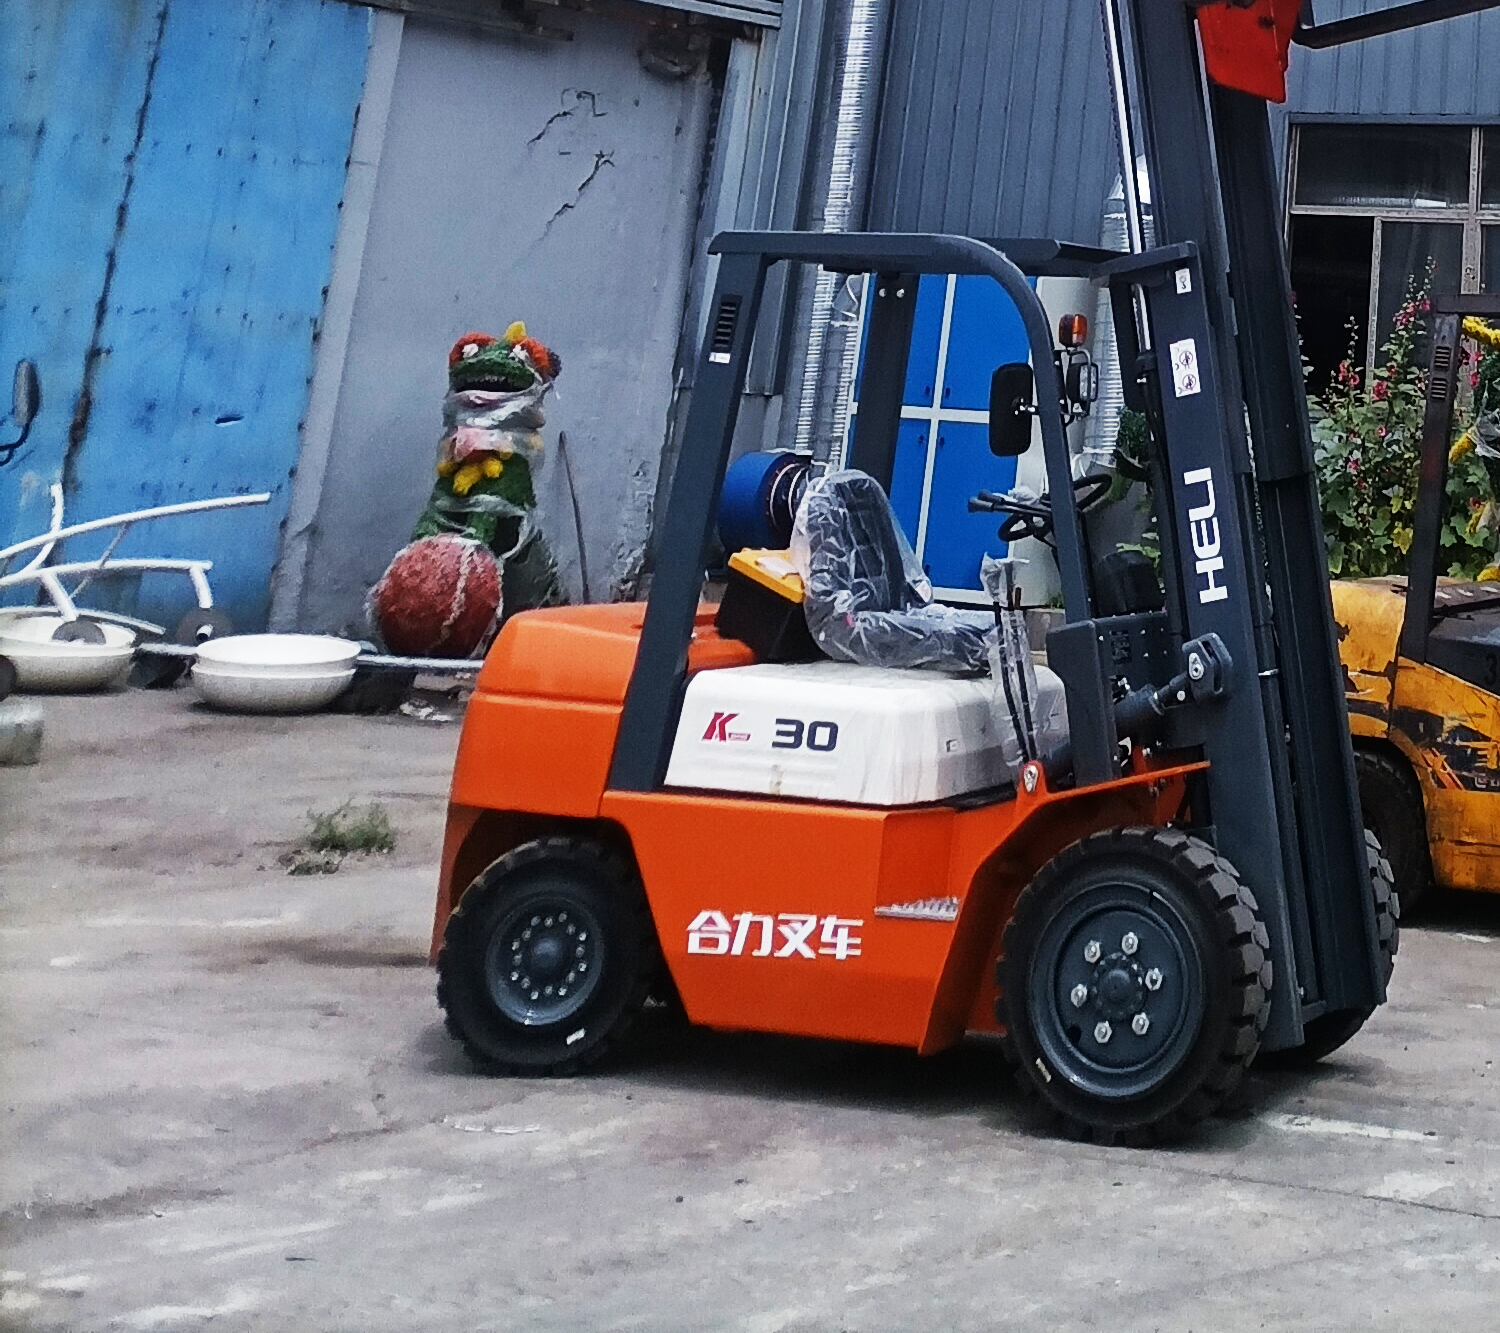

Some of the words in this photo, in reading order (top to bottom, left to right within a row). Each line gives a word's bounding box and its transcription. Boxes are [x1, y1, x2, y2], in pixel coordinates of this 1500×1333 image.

[1184, 467, 1228, 603] HELI
[701, 712, 739, 742] K
[772, 718, 839, 751] 30
[686, 910, 864, 960] 合力叉车
